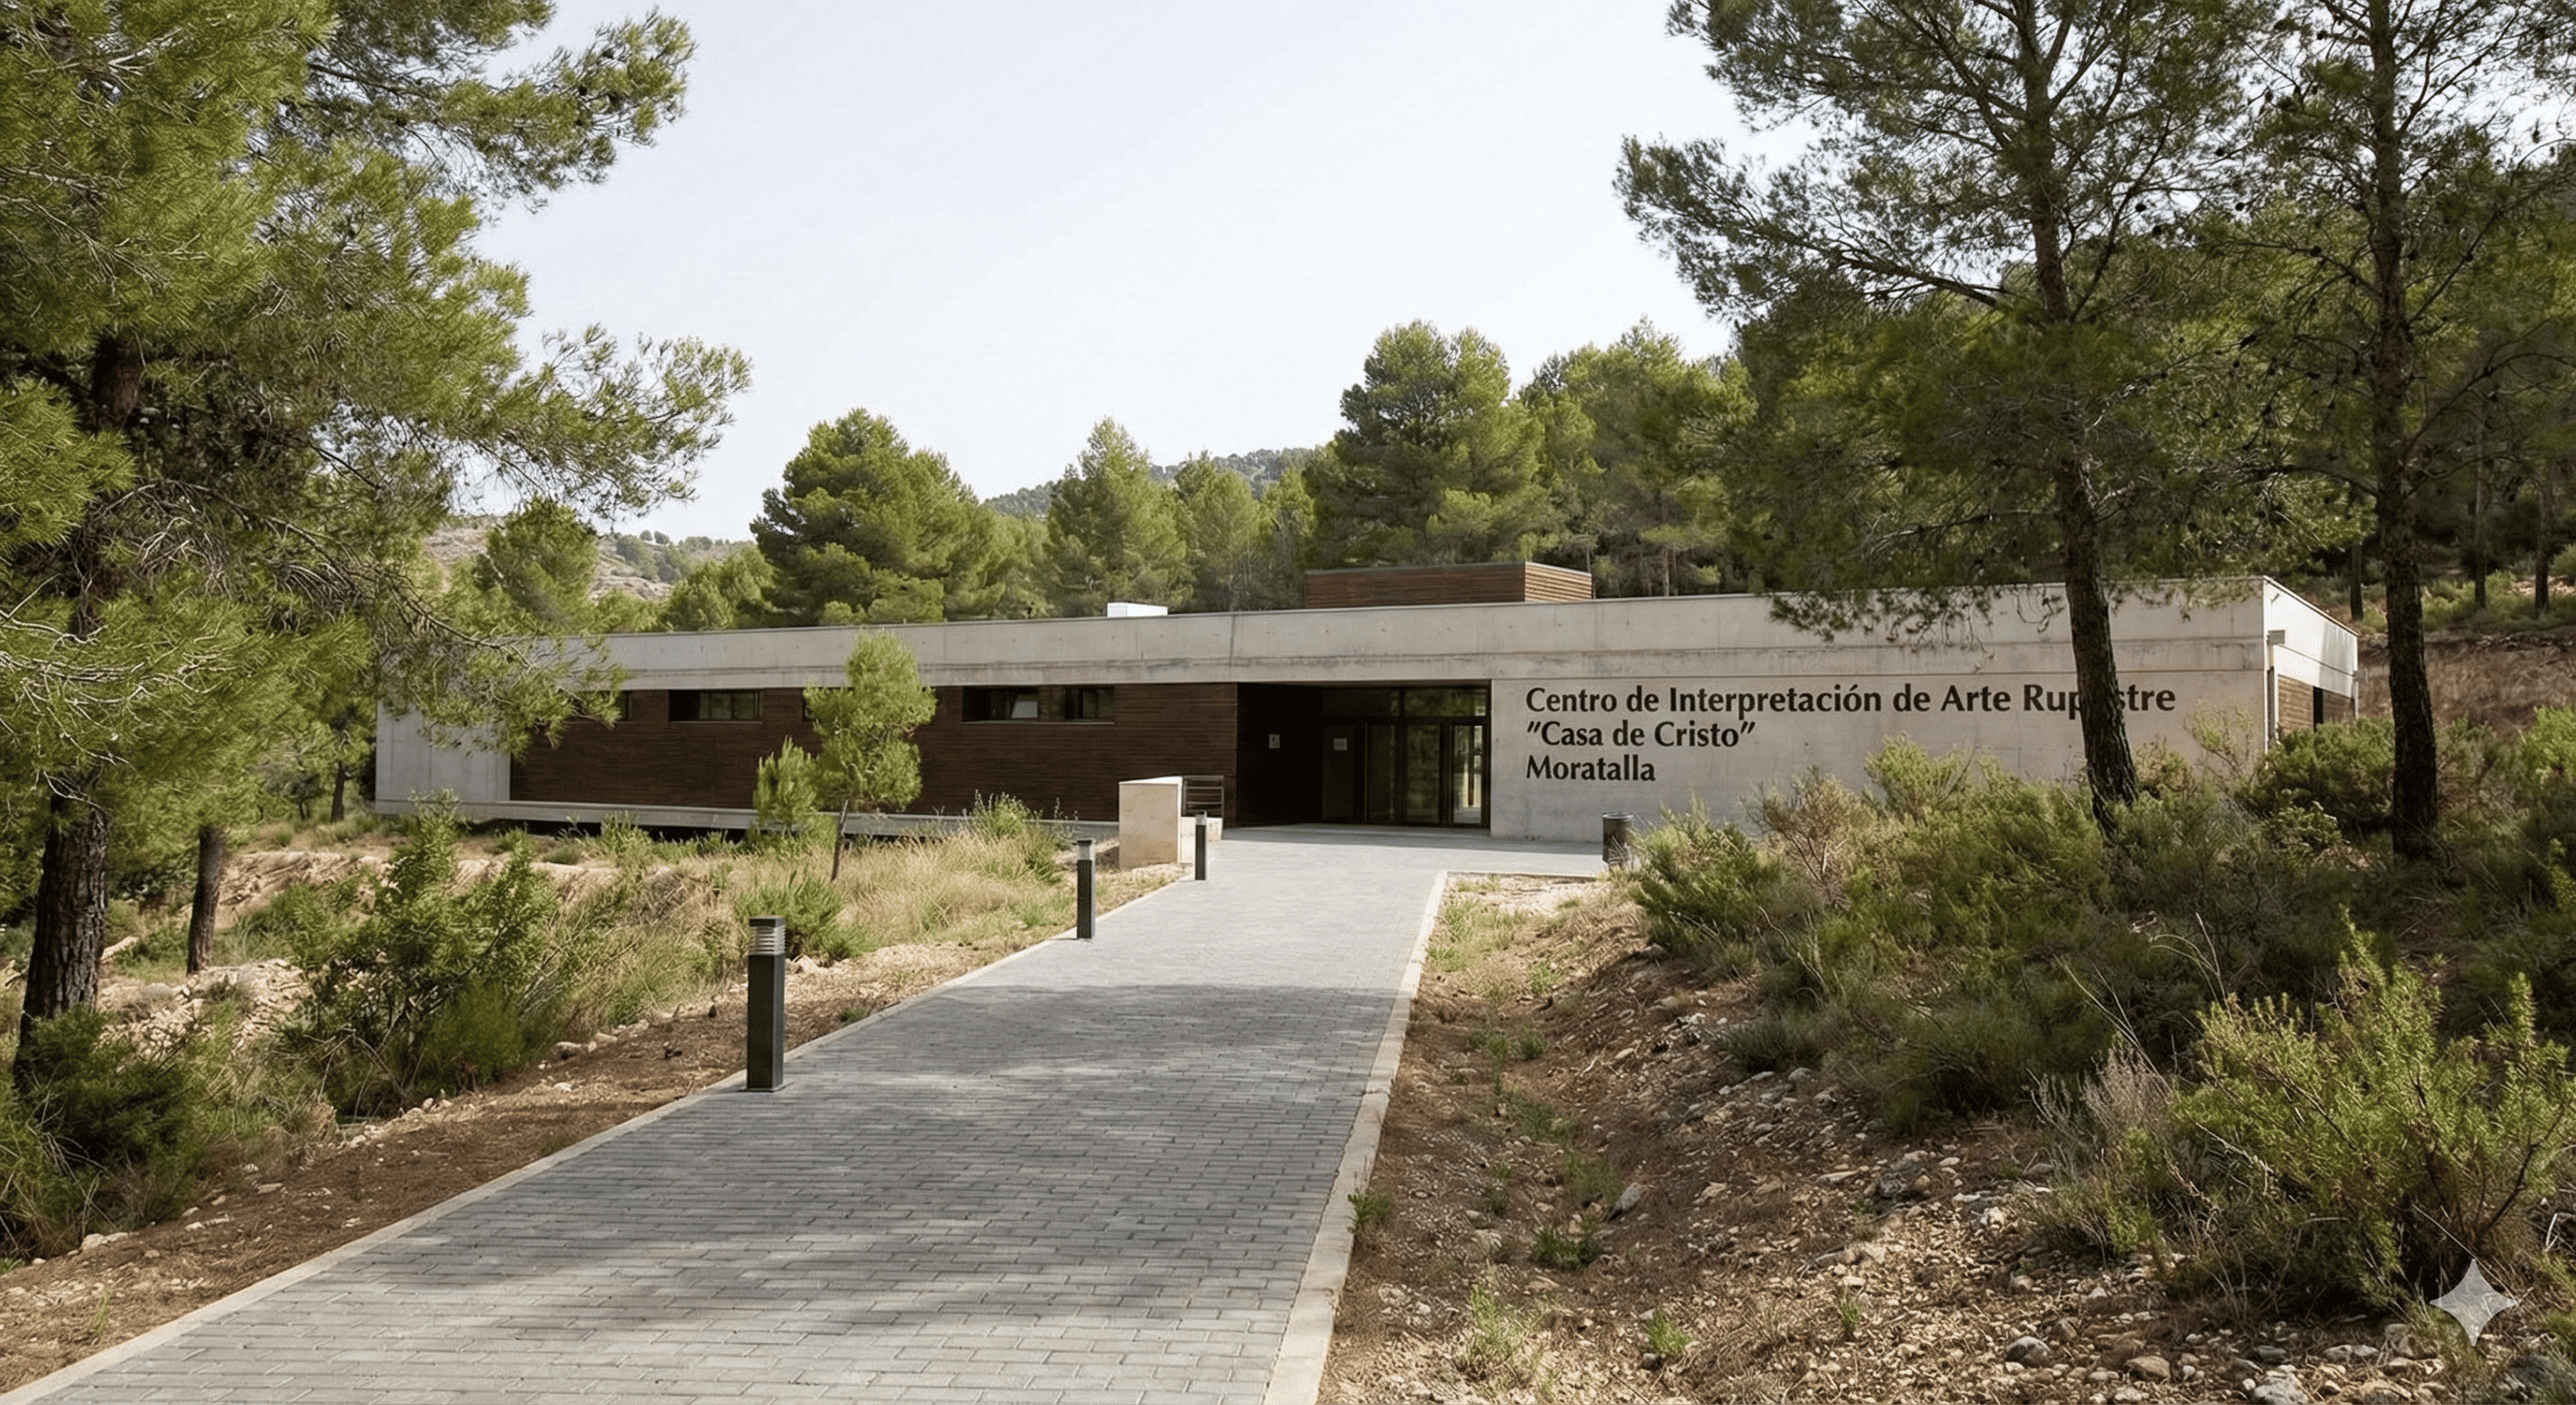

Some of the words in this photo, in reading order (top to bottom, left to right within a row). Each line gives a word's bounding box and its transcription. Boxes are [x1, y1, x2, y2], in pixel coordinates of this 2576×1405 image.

[1526, 687, 1617, 713] Centro
[1626, 685, 1659, 713] de
[1669, 684, 1882, 721] Interpretación
[1893, 683, 1931, 712] de
[1940, 685, 2012, 712] Arte
[2023, 684, 2176, 720] Rupstre
[1527, 721, 1604, 746] "Casa
[1612, 719, 1646, 746] de
[1654, 719, 1756, 747] Cristo"
[1526, 755, 1656, 781] Moratalla
